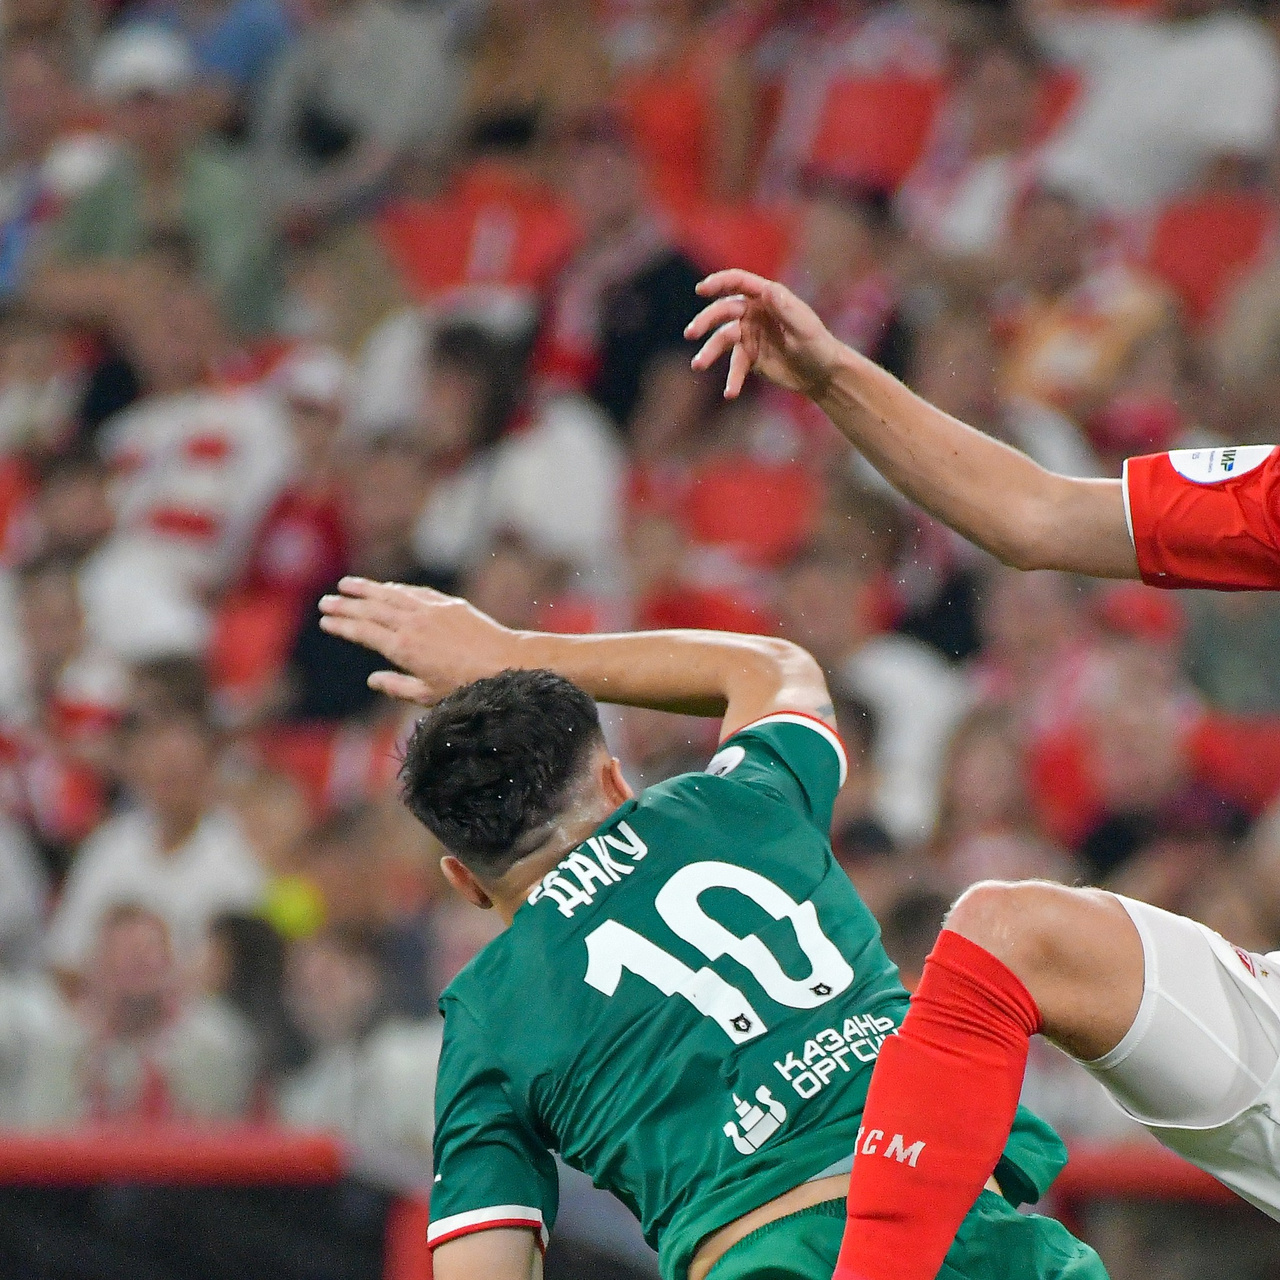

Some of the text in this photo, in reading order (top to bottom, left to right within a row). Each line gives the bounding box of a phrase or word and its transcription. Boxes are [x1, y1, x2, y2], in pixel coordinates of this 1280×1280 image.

[527, 820, 649, 918] ДАКУ
[583, 860, 855, 1046] 10
[773, 1013, 895, 1081] КАЗАНЬ
[792, 1028, 899, 1099] ОРГСИ
